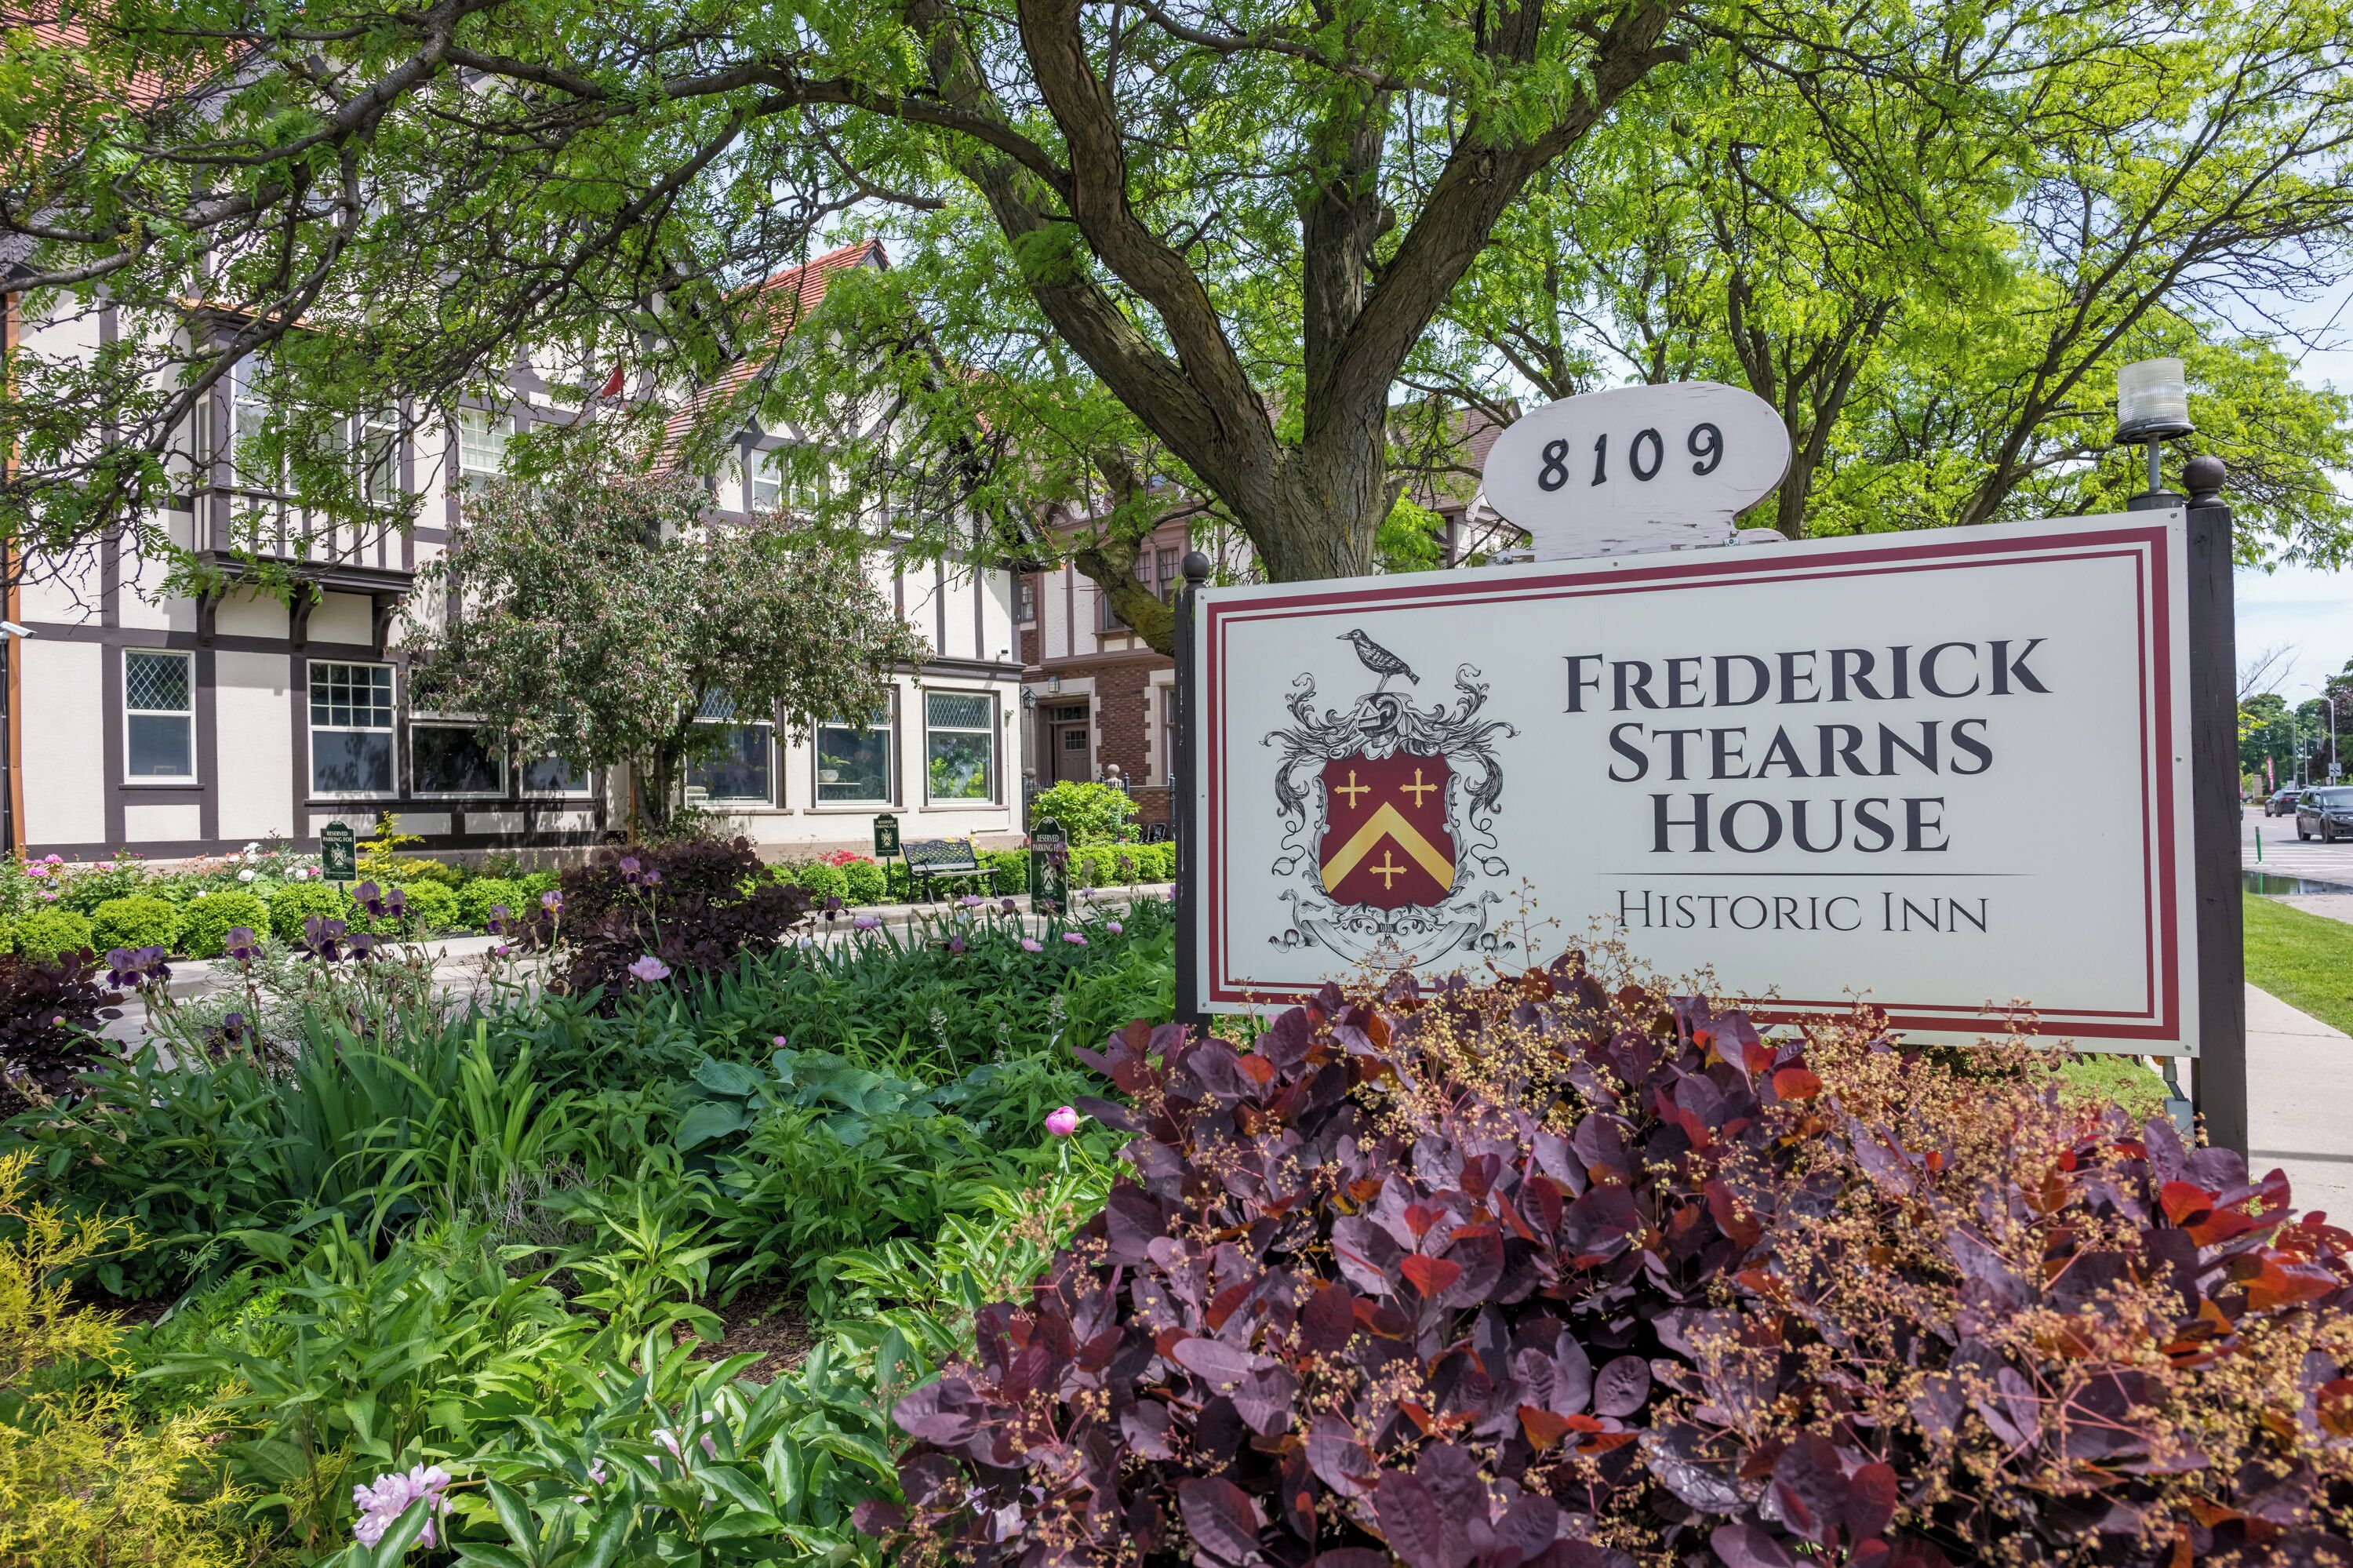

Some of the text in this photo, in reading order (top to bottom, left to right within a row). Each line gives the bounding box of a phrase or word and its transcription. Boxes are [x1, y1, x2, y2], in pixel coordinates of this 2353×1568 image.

[1537, 422, 1724, 493] 8109
[1561, 638, 2054, 714] FREDERICK
[1608, 719, 1994, 783] STEARNS
[1032, 843, 1053, 852] PARKING
[1036, 834, 1060, 842] RESERVED
[1647, 793, 1951, 853] HOUSE
[1617, 890, 1989, 933] HISTORIC INN
